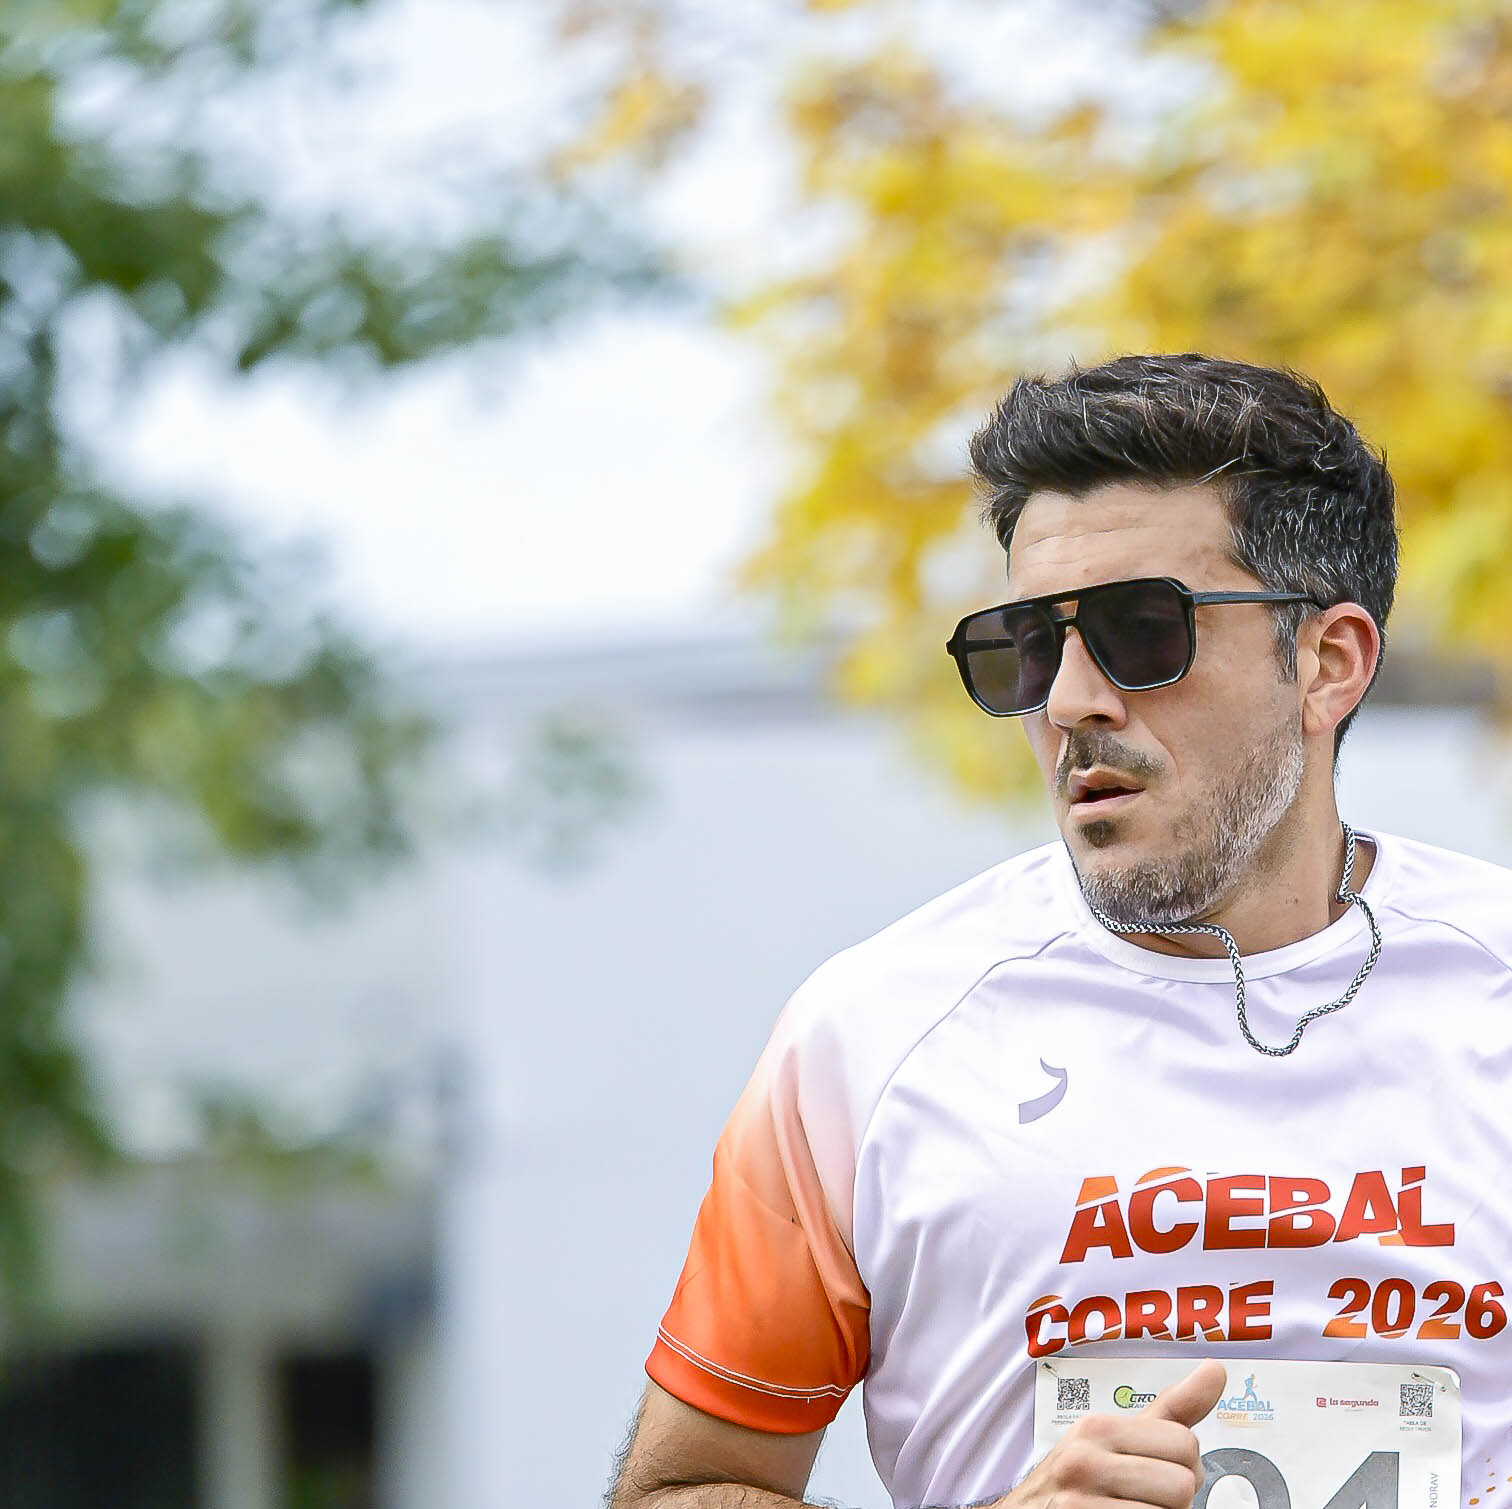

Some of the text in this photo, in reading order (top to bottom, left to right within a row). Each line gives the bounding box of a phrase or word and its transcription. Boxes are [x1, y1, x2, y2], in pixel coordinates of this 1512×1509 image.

[1059, 1166, 1455, 1264] ACEBAL
[1025, 1278, 1507, 1358] CORRE 2026
[1217, 1397, 1274, 1411] ACEBAL
